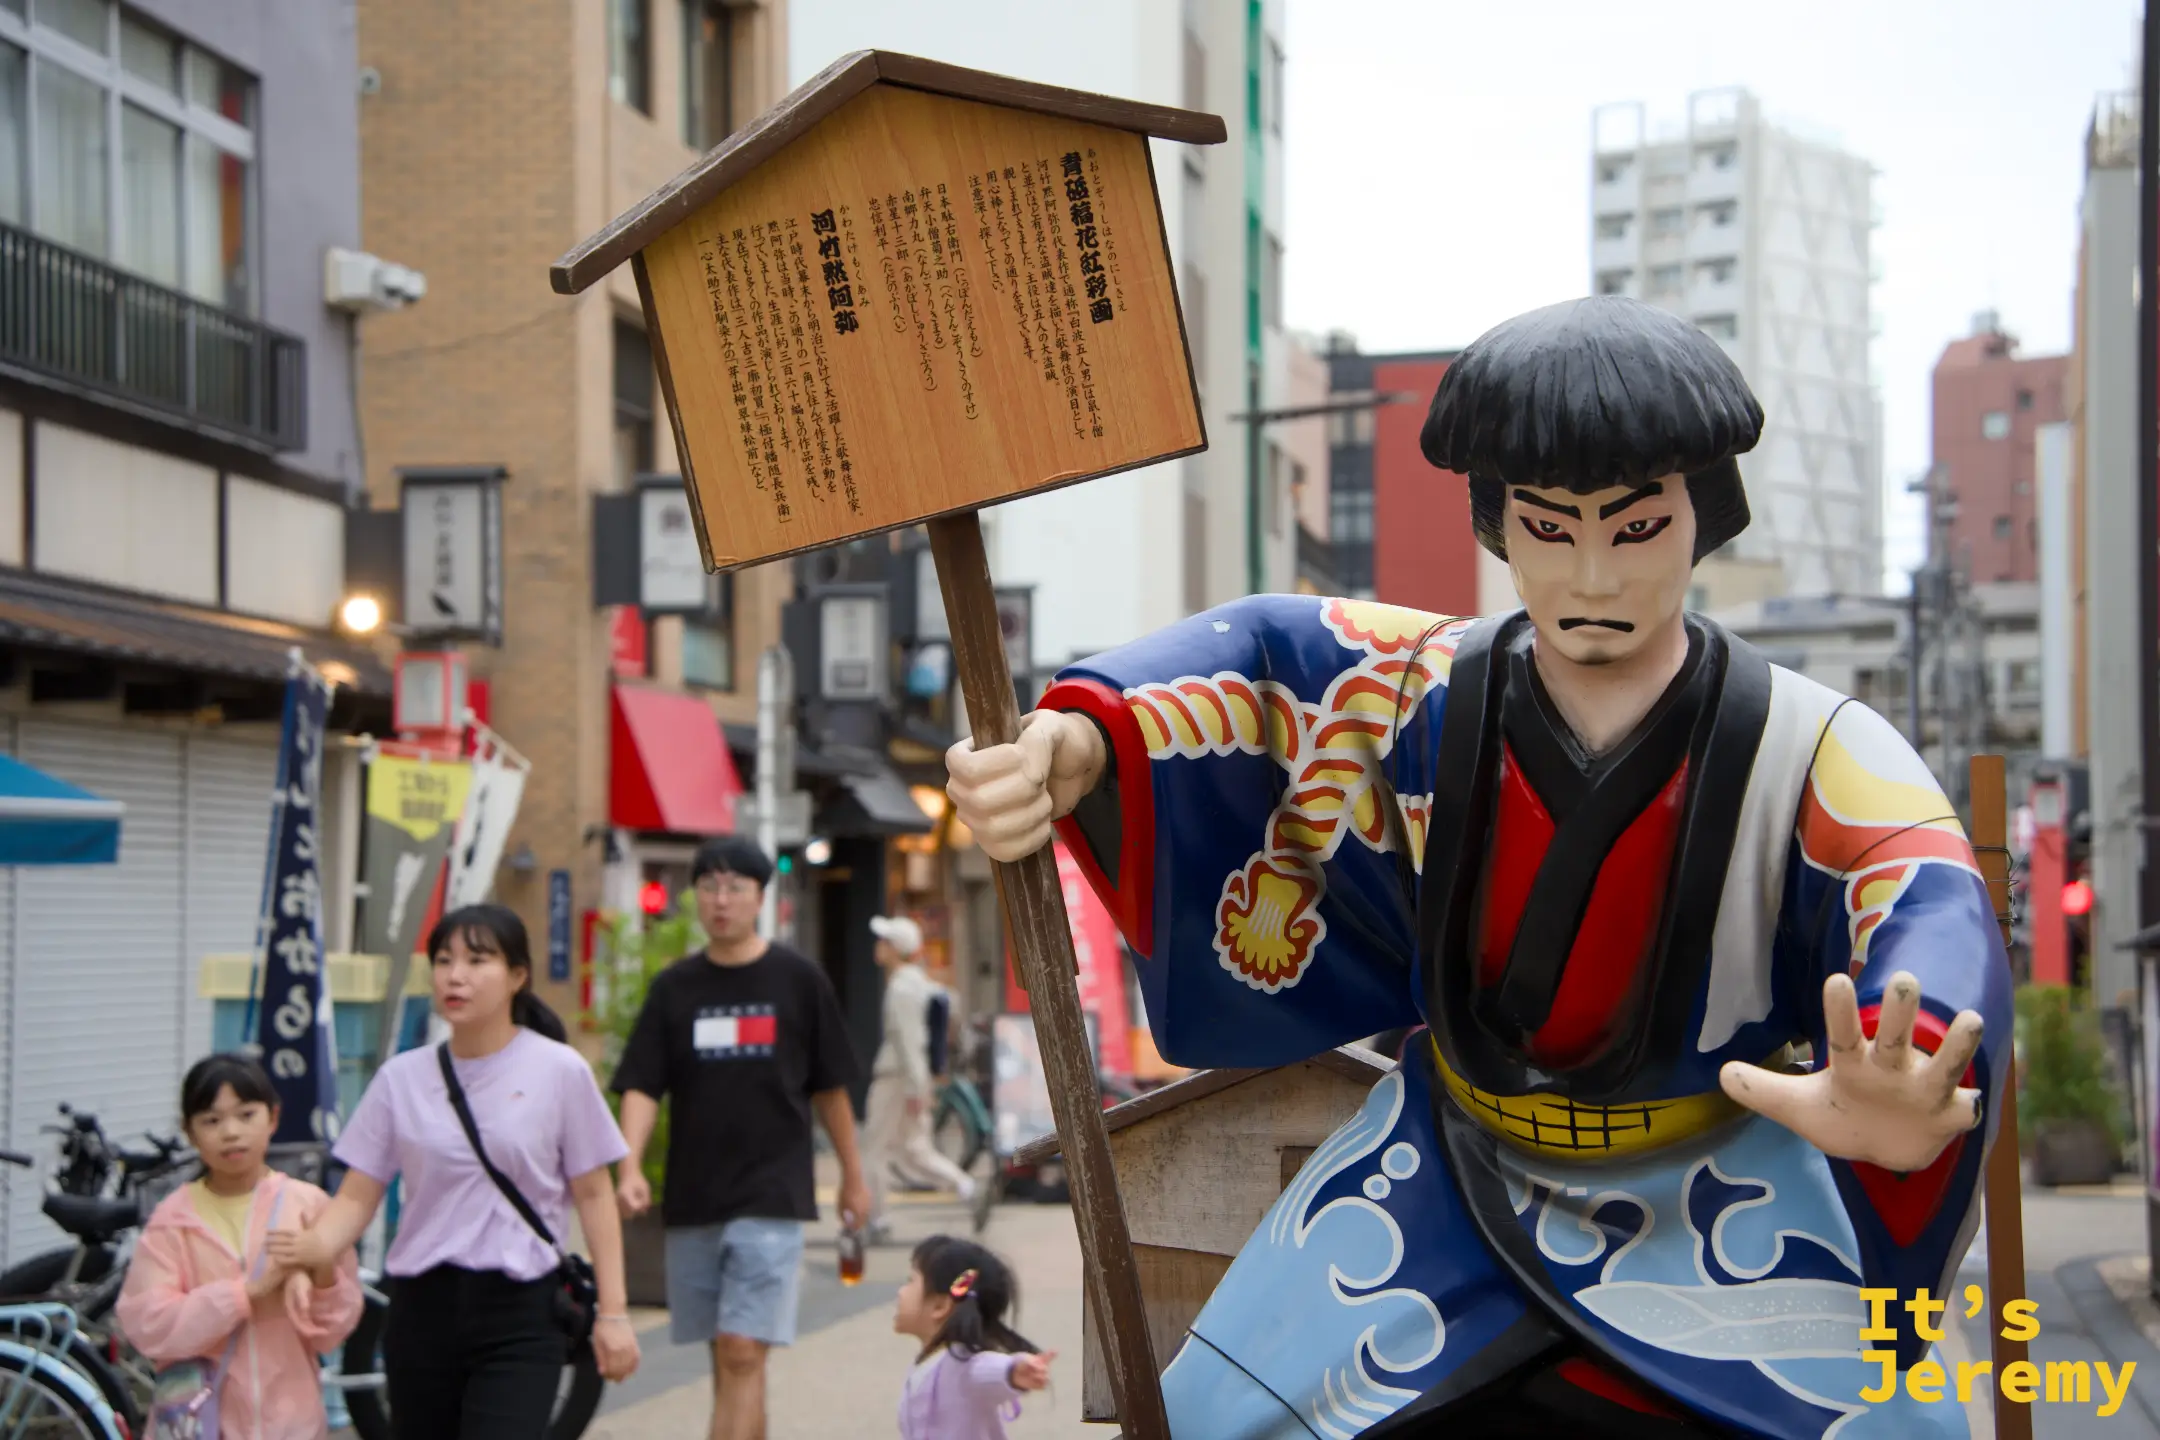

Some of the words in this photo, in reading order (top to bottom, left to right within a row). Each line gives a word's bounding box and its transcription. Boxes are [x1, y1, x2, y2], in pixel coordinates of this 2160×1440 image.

[839, 204, 871, 308] かわたけもくあみ
[968, 174, 1005, 294] 注意深く探して下さい。
[1087, 148, 1128, 312] あおとぞうしはなのにしきえ
